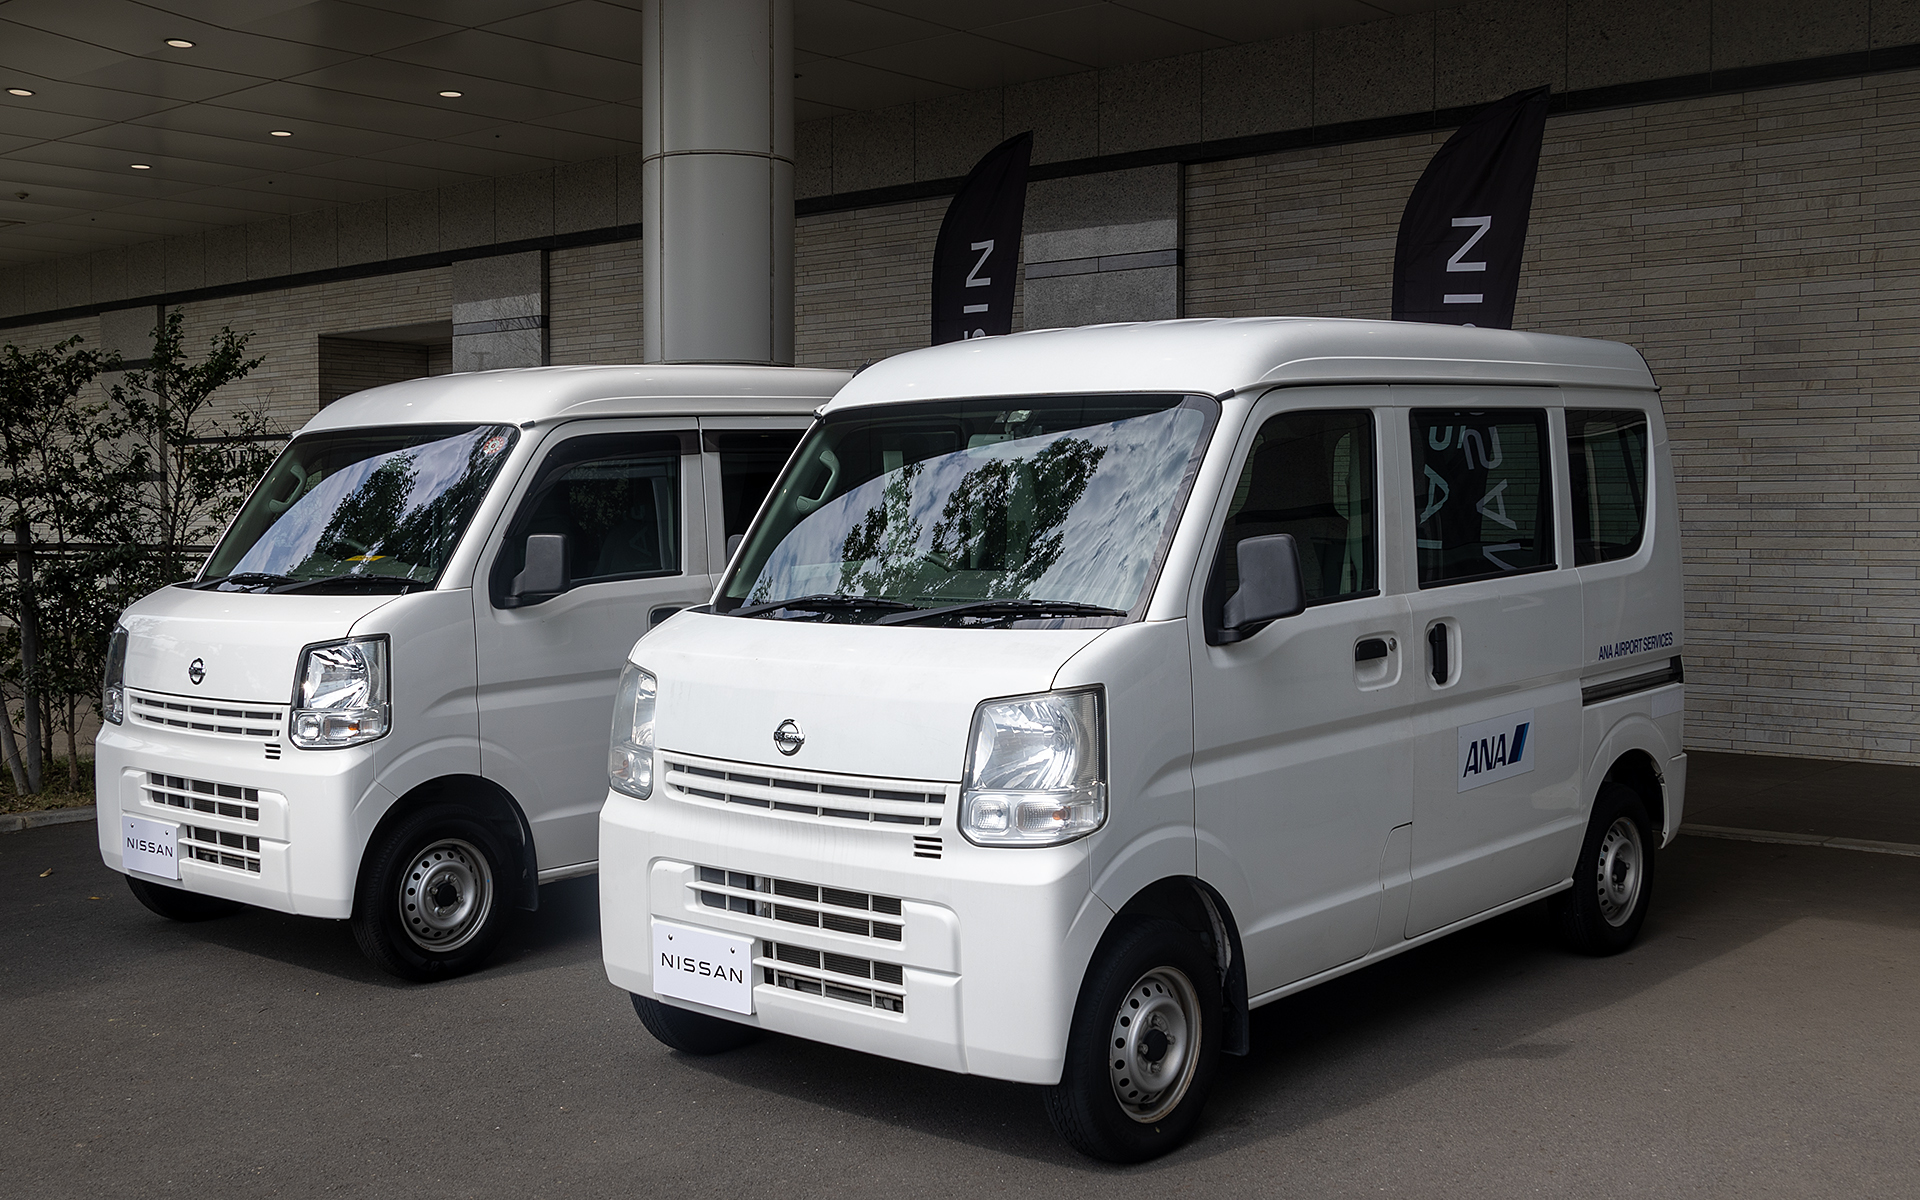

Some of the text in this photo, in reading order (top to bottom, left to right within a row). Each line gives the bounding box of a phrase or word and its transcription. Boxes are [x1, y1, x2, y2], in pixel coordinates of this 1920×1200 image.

[1442, 214, 1493, 328] NI
[1598, 631, 1673, 661] ANA AIRPORT SERVICES
[1462, 733, 1507, 778] ANA
[126, 837, 173, 858] NISSAN
[661, 952, 743, 984] NISSAN
